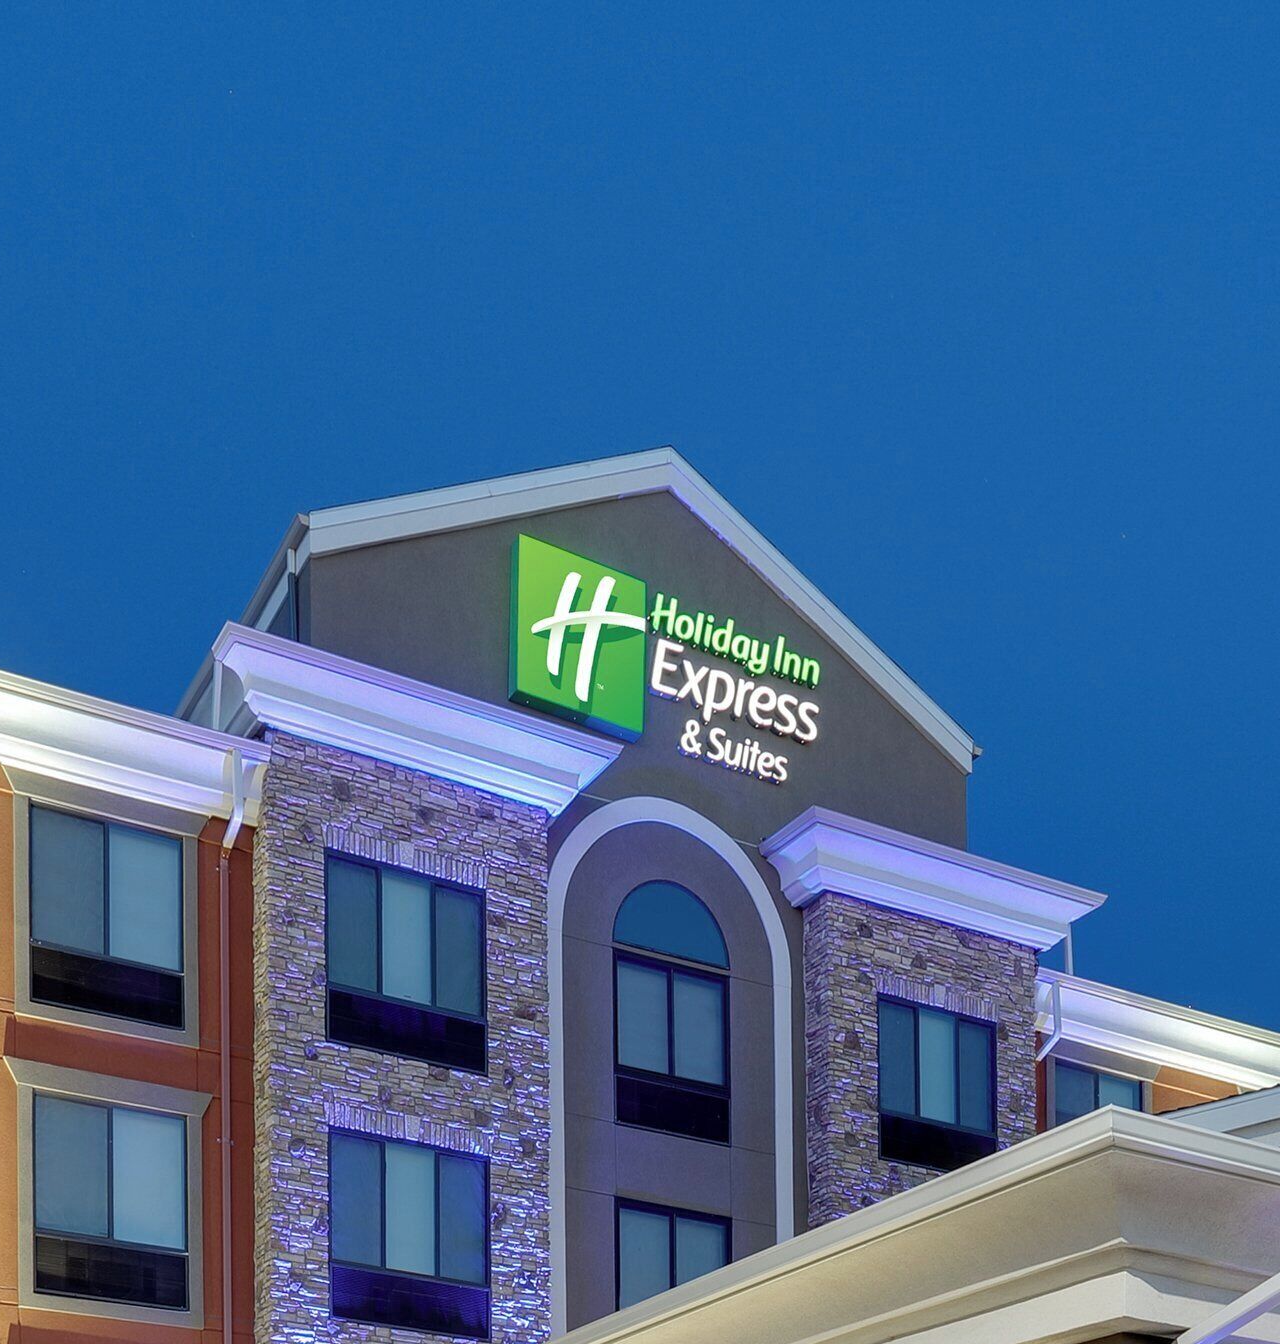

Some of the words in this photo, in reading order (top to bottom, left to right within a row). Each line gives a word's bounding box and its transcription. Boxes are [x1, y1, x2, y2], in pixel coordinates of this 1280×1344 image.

[651, 592, 770, 674] Holiday
[775, 635, 820, 687] Inn
[650, 638, 819, 742] Express
[680, 719, 702, 754] &
[708, 727, 788, 783] Suites
